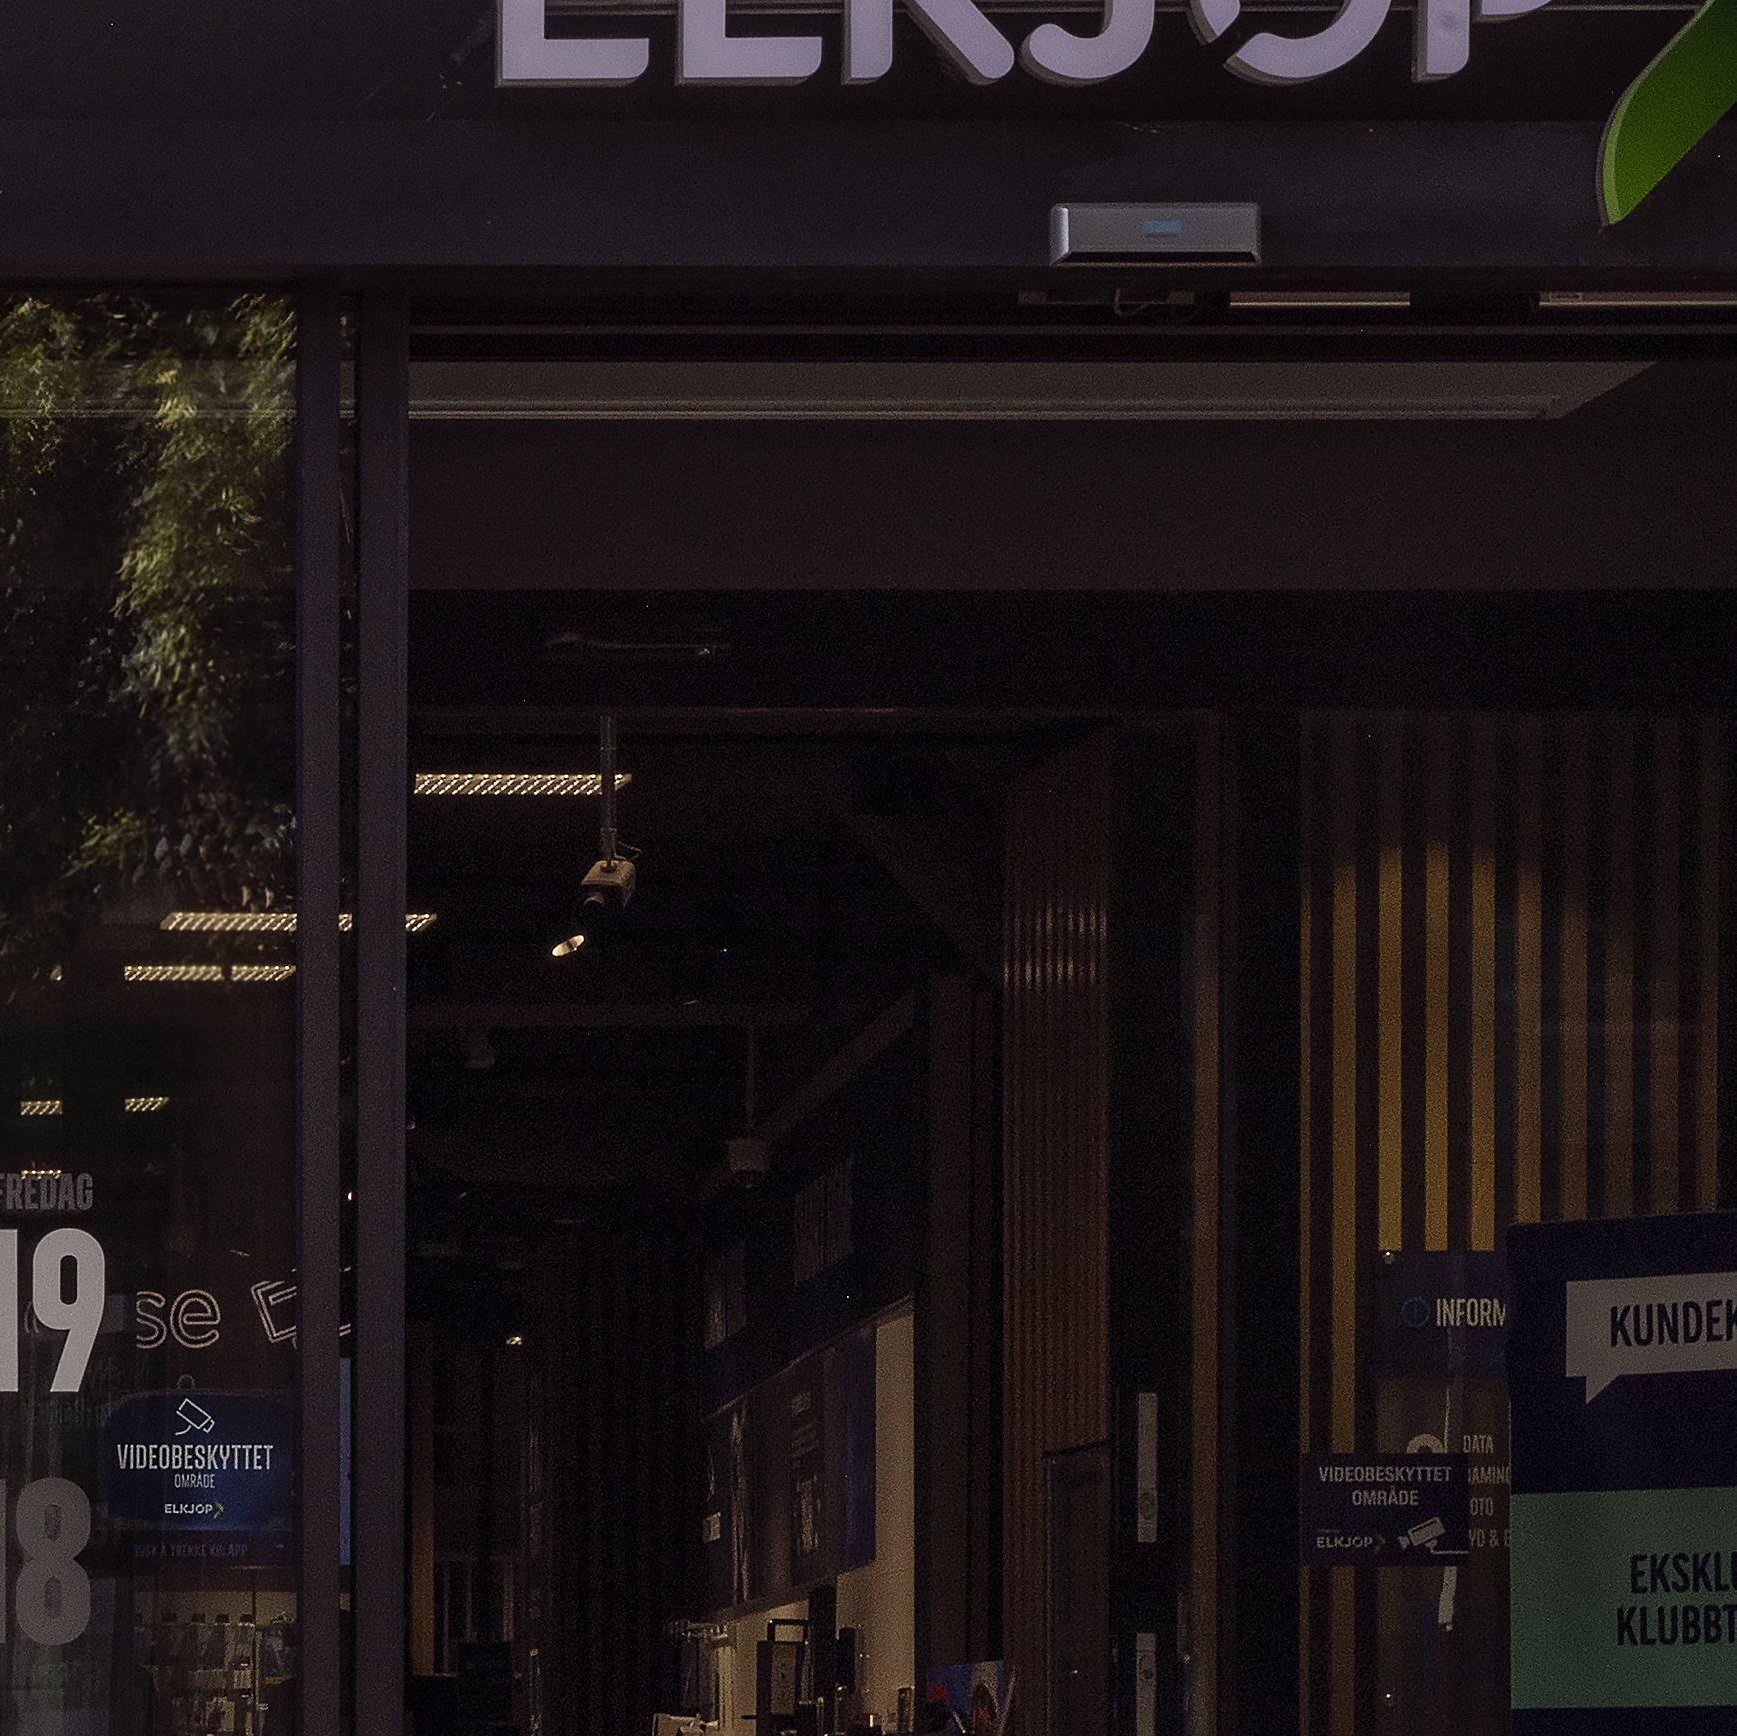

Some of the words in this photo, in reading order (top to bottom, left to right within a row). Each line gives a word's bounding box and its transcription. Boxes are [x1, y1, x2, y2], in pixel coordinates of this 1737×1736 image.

[1462, 1433, 1495, 1454] DATA
[116, 1443, 274, 1471] VIDEOBESKYTTET
[173, 1472, 216, 1489] OMRÅDE
[1318, 1466, 1451, 1483] VIDEOBESKYTTET
[1351, 1486, 1420, 1507] OMRÅDE
